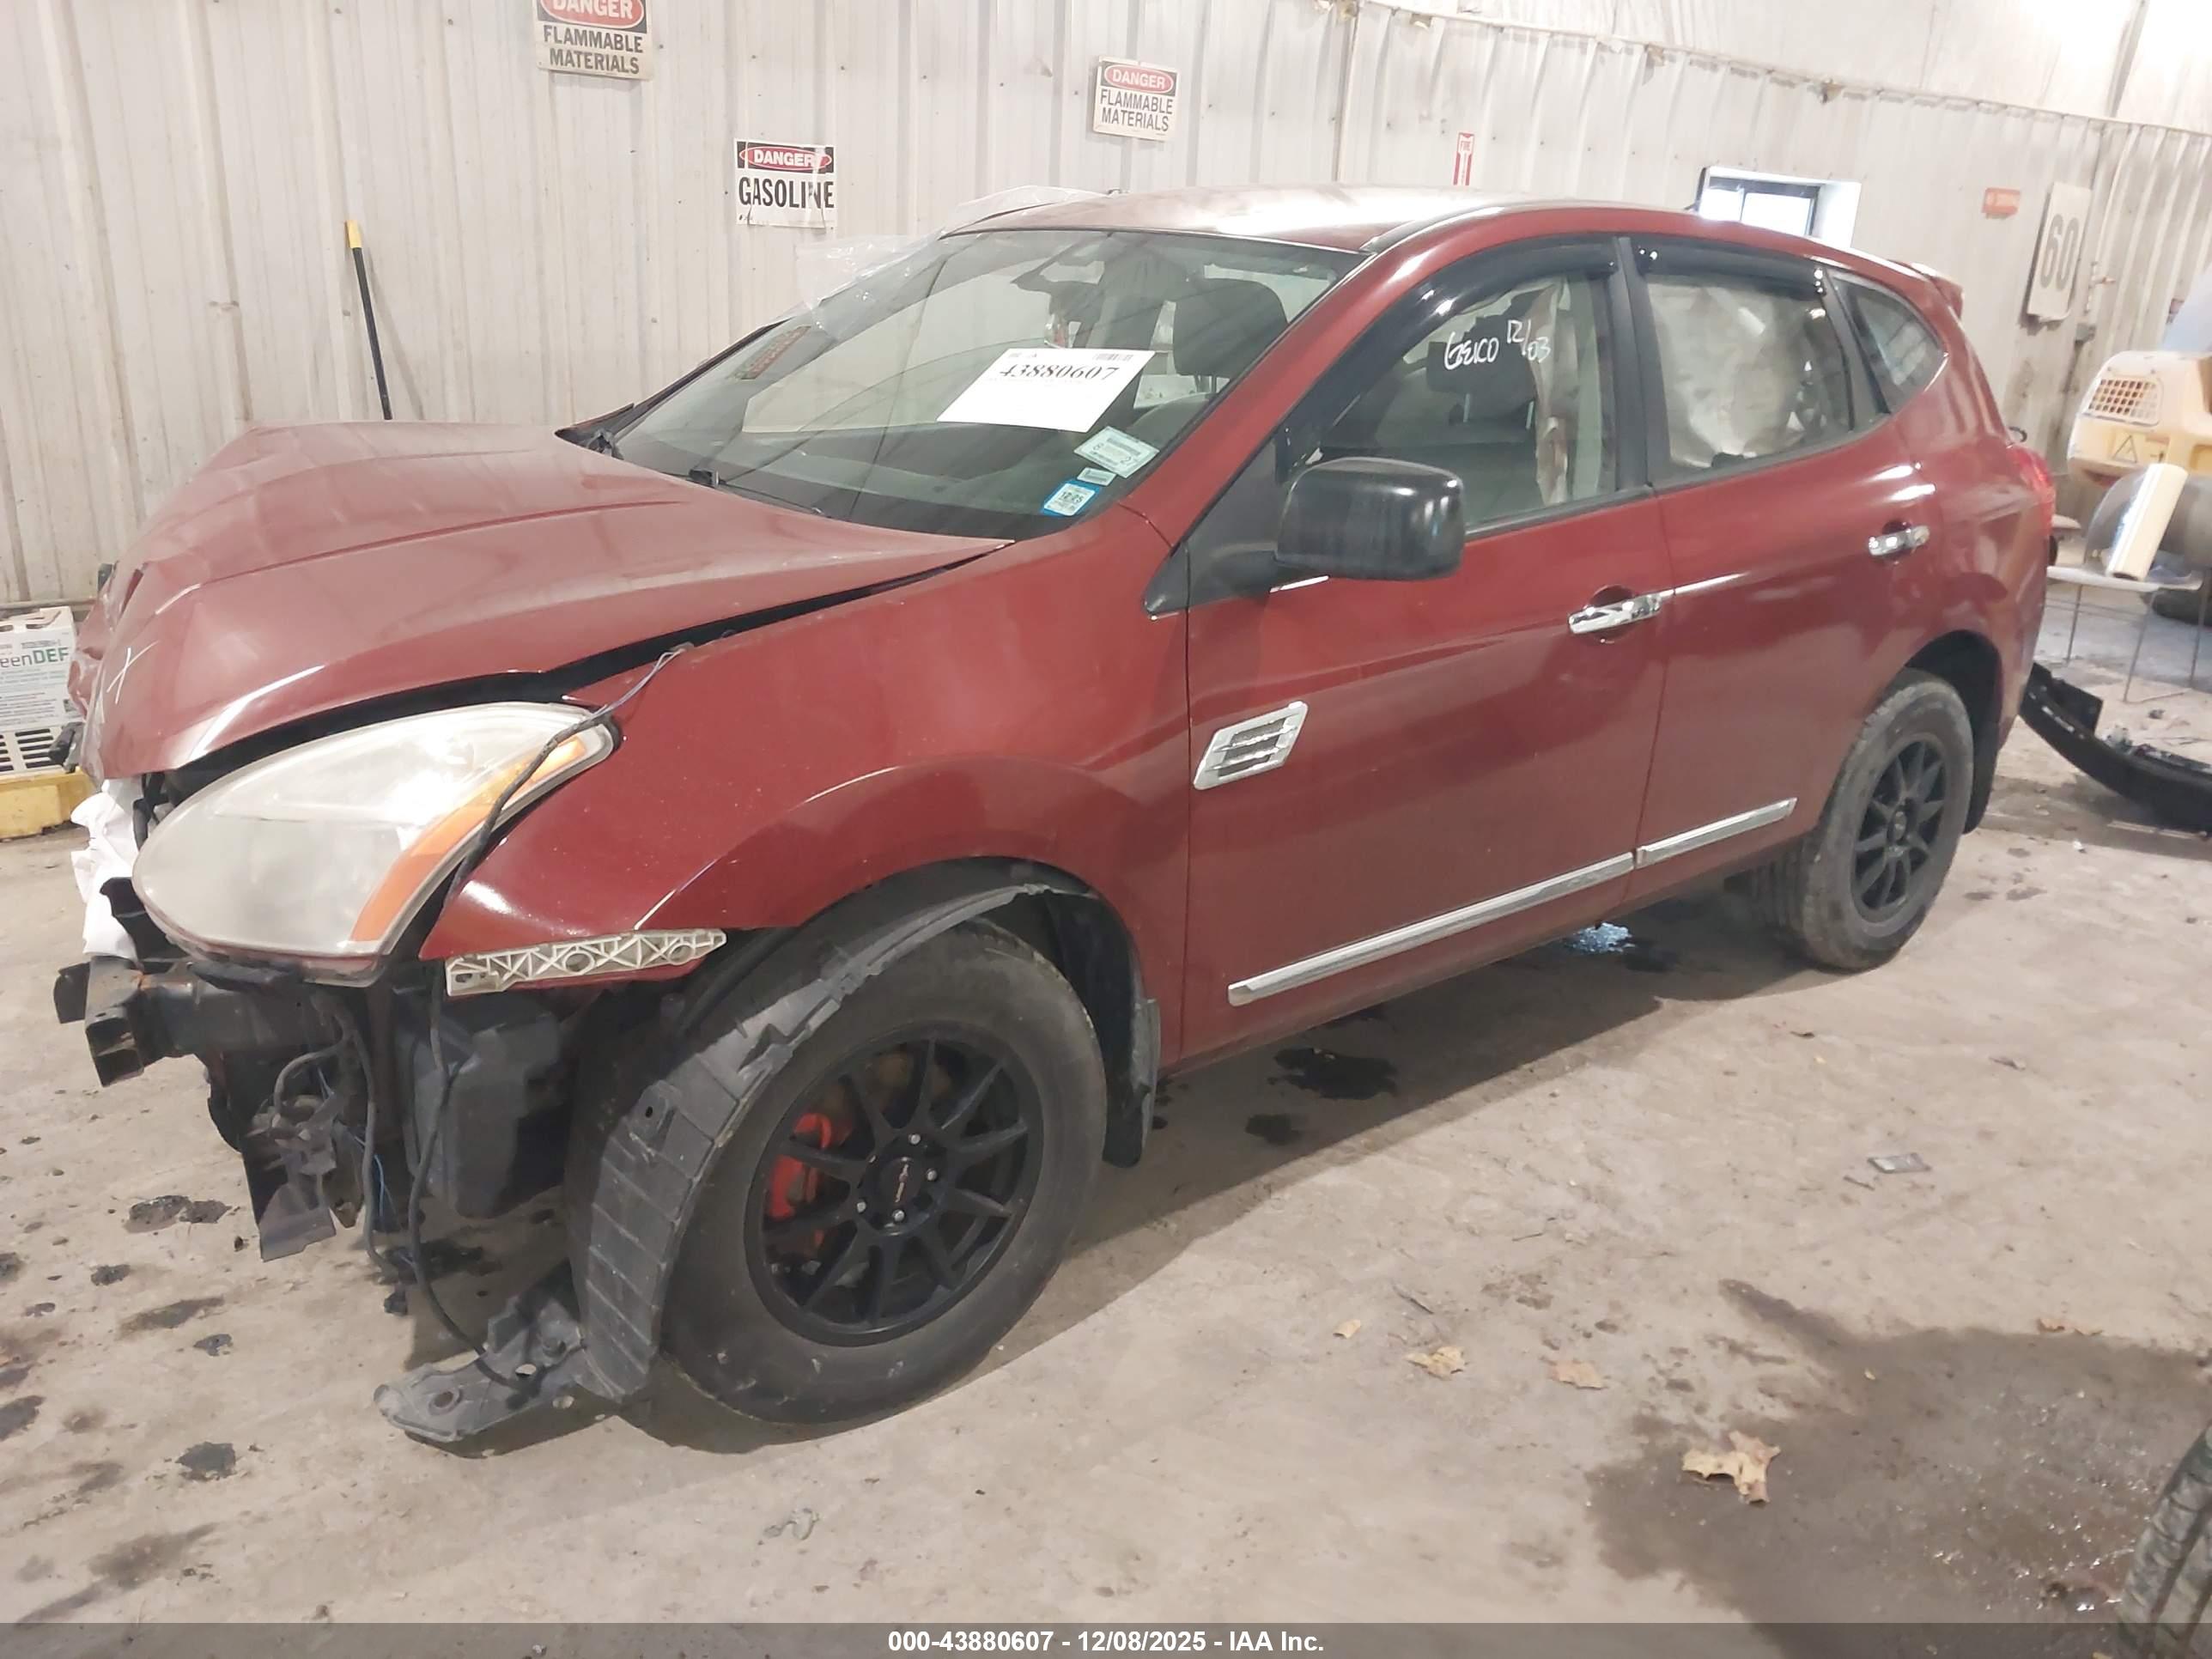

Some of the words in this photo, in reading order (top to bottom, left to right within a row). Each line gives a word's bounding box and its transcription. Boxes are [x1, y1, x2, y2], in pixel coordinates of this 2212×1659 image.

[552, 0, 633, 19] DANGER
[544, 25, 643, 53] FLAMMABLE
[550, 48, 640, 75] MATERIALS
[1112, 69, 1165, 89] DANGER
[1100, 88, 1173, 114] FLAMMABLE
[1102, 107, 1170, 131] MATERIALS
[754, 149, 820, 167] DANGER
[738, 177, 835, 209] GASOLINE
[2040, 214, 2079, 291] 60
[1444, 331, 1499, 370] GEICO
[1000, 364, 1119, 380] 43880607
